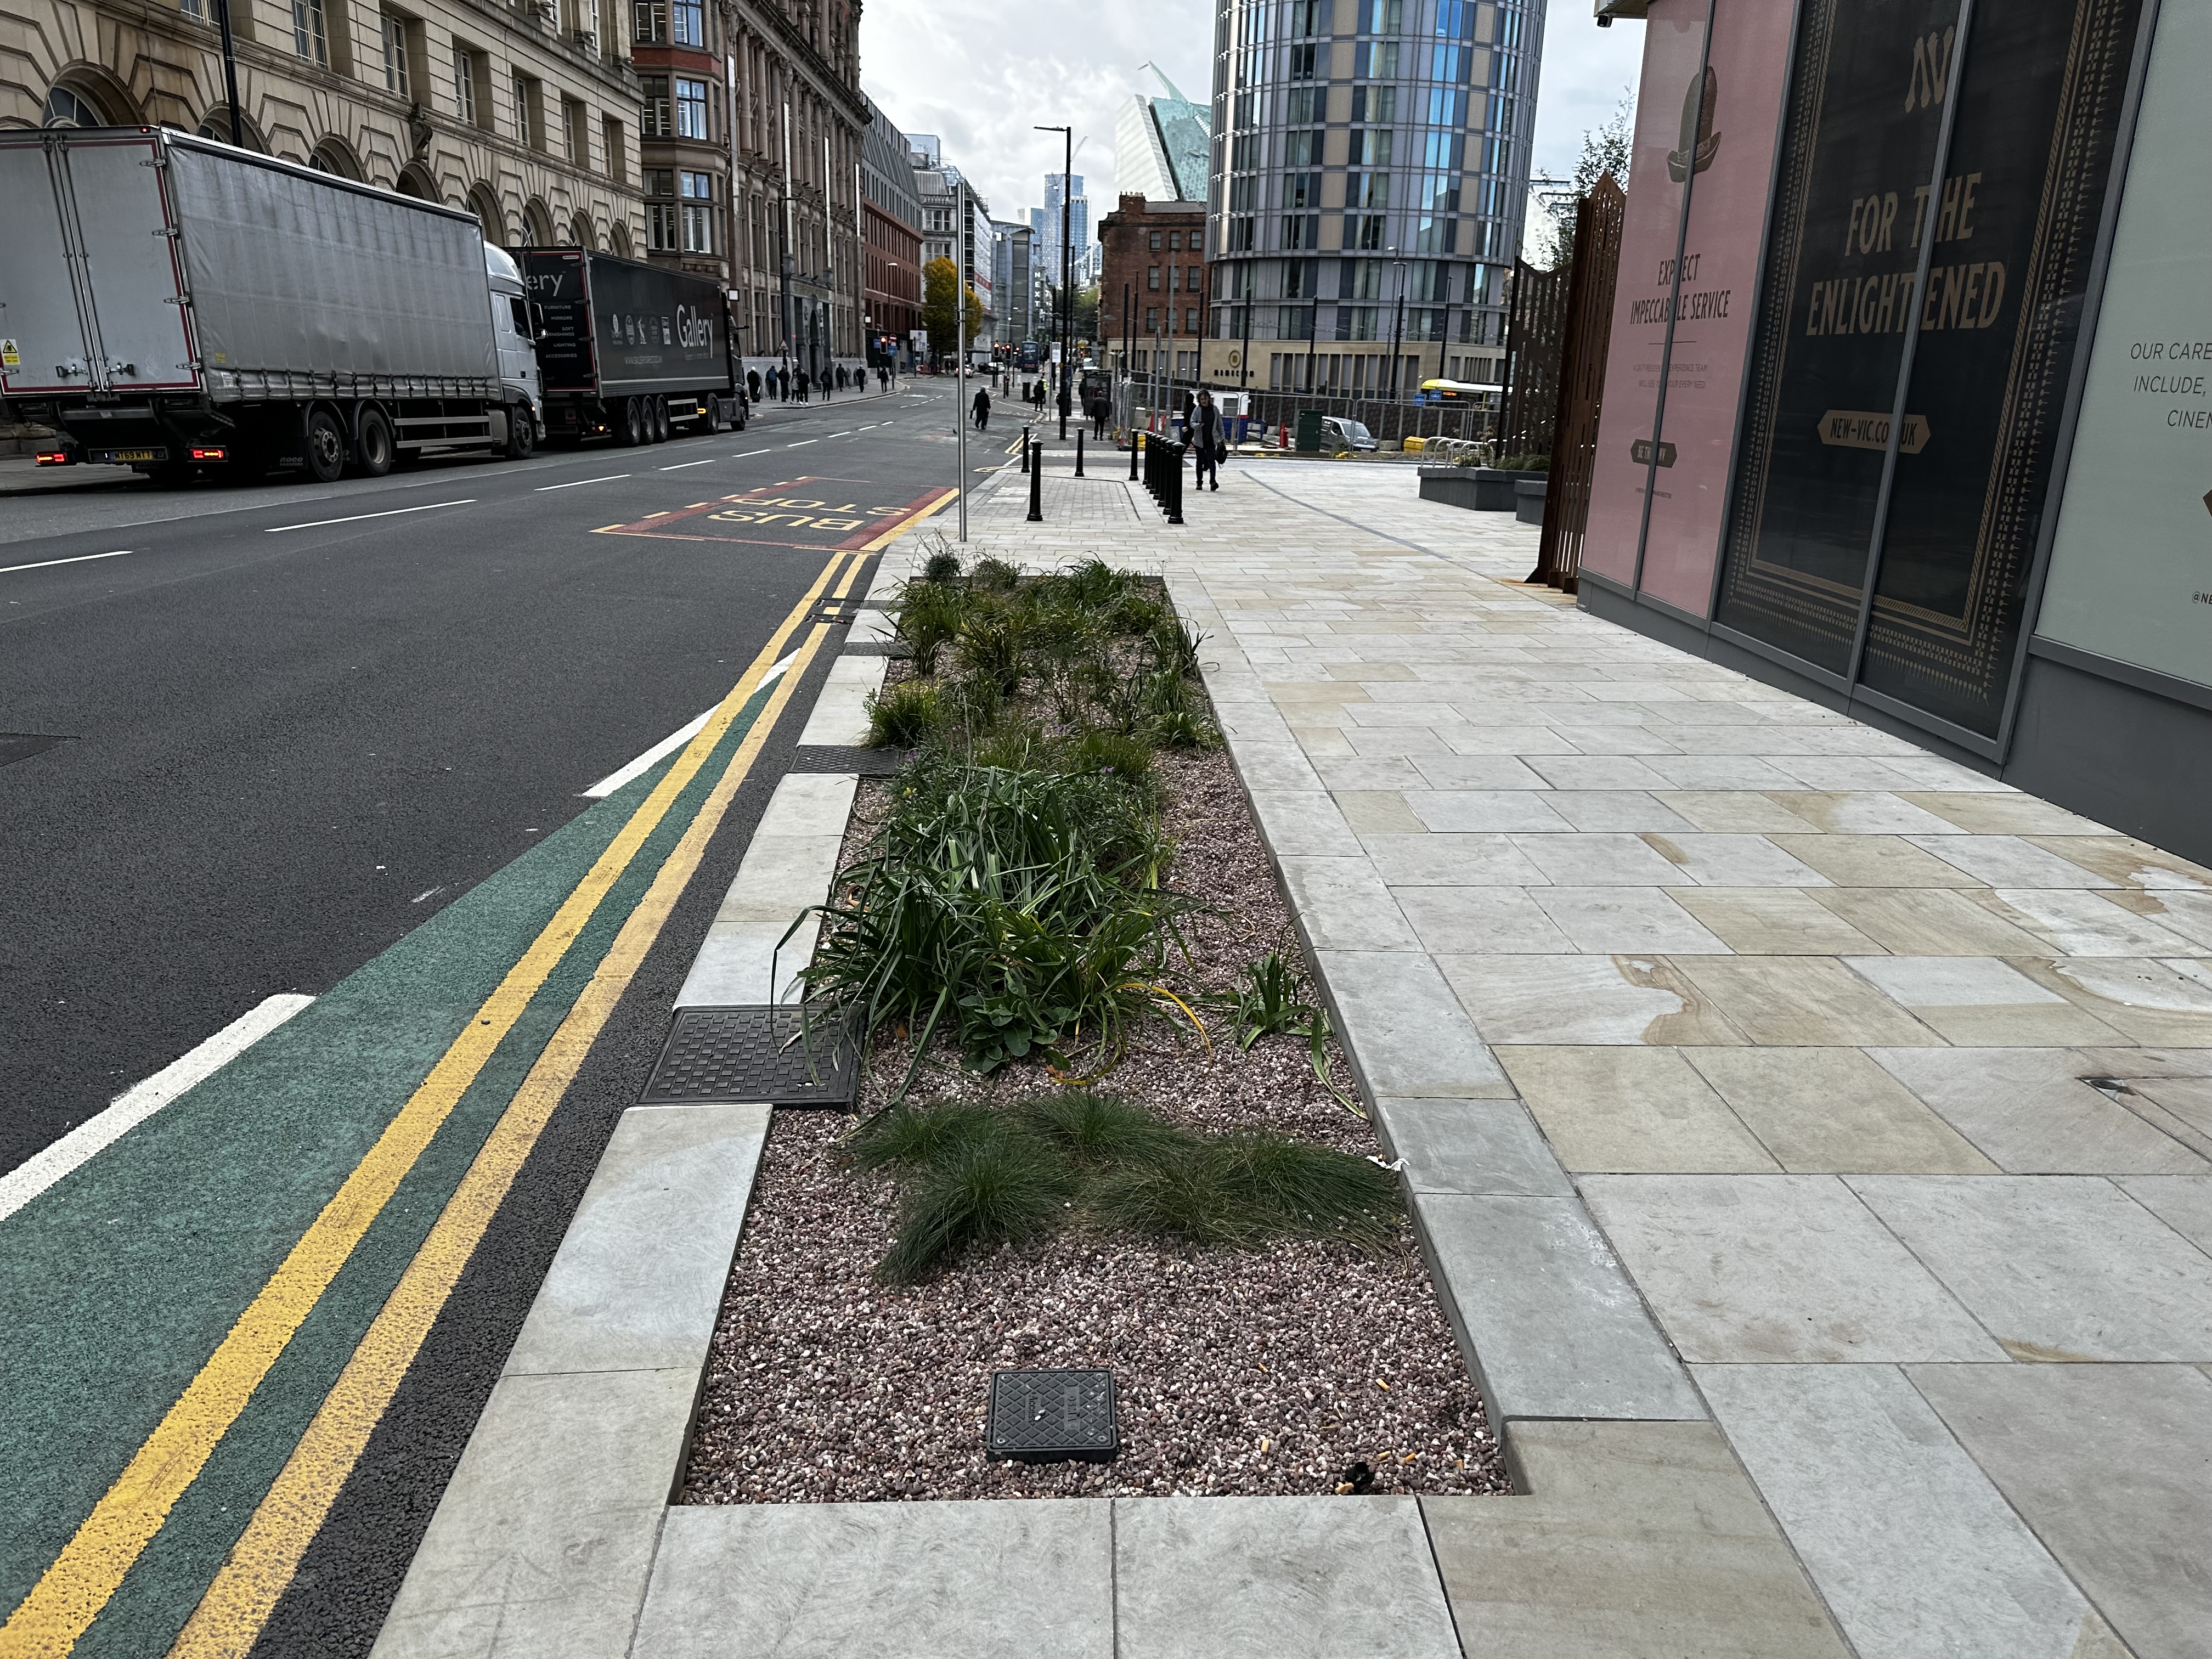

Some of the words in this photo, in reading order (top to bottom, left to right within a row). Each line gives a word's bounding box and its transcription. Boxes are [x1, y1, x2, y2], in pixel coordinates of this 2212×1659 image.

[1844, 191, 1898, 257] FOR
[1910, 172, 1982, 249] THE
[1657, 253, 1701, 286] EXPECT
[1630, 294, 1689, 325] IMPECCABLE
[1690, 290, 1731, 320] SERVICE
[1805, 261, 2006, 336] ENLIGHTENED
[676, 304, 713, 359] Gallery
[2130, 343, 2164, 359] OUR
[2169, 342, 2212, 359] CARE
[2134, 375, 2205, 397] INCLUDE,
[1830, 417, 1917, 446] NEW-VIC.COUK
[707, 510, 865, 531] BUS
[732, 498, 911, 516] STOP
